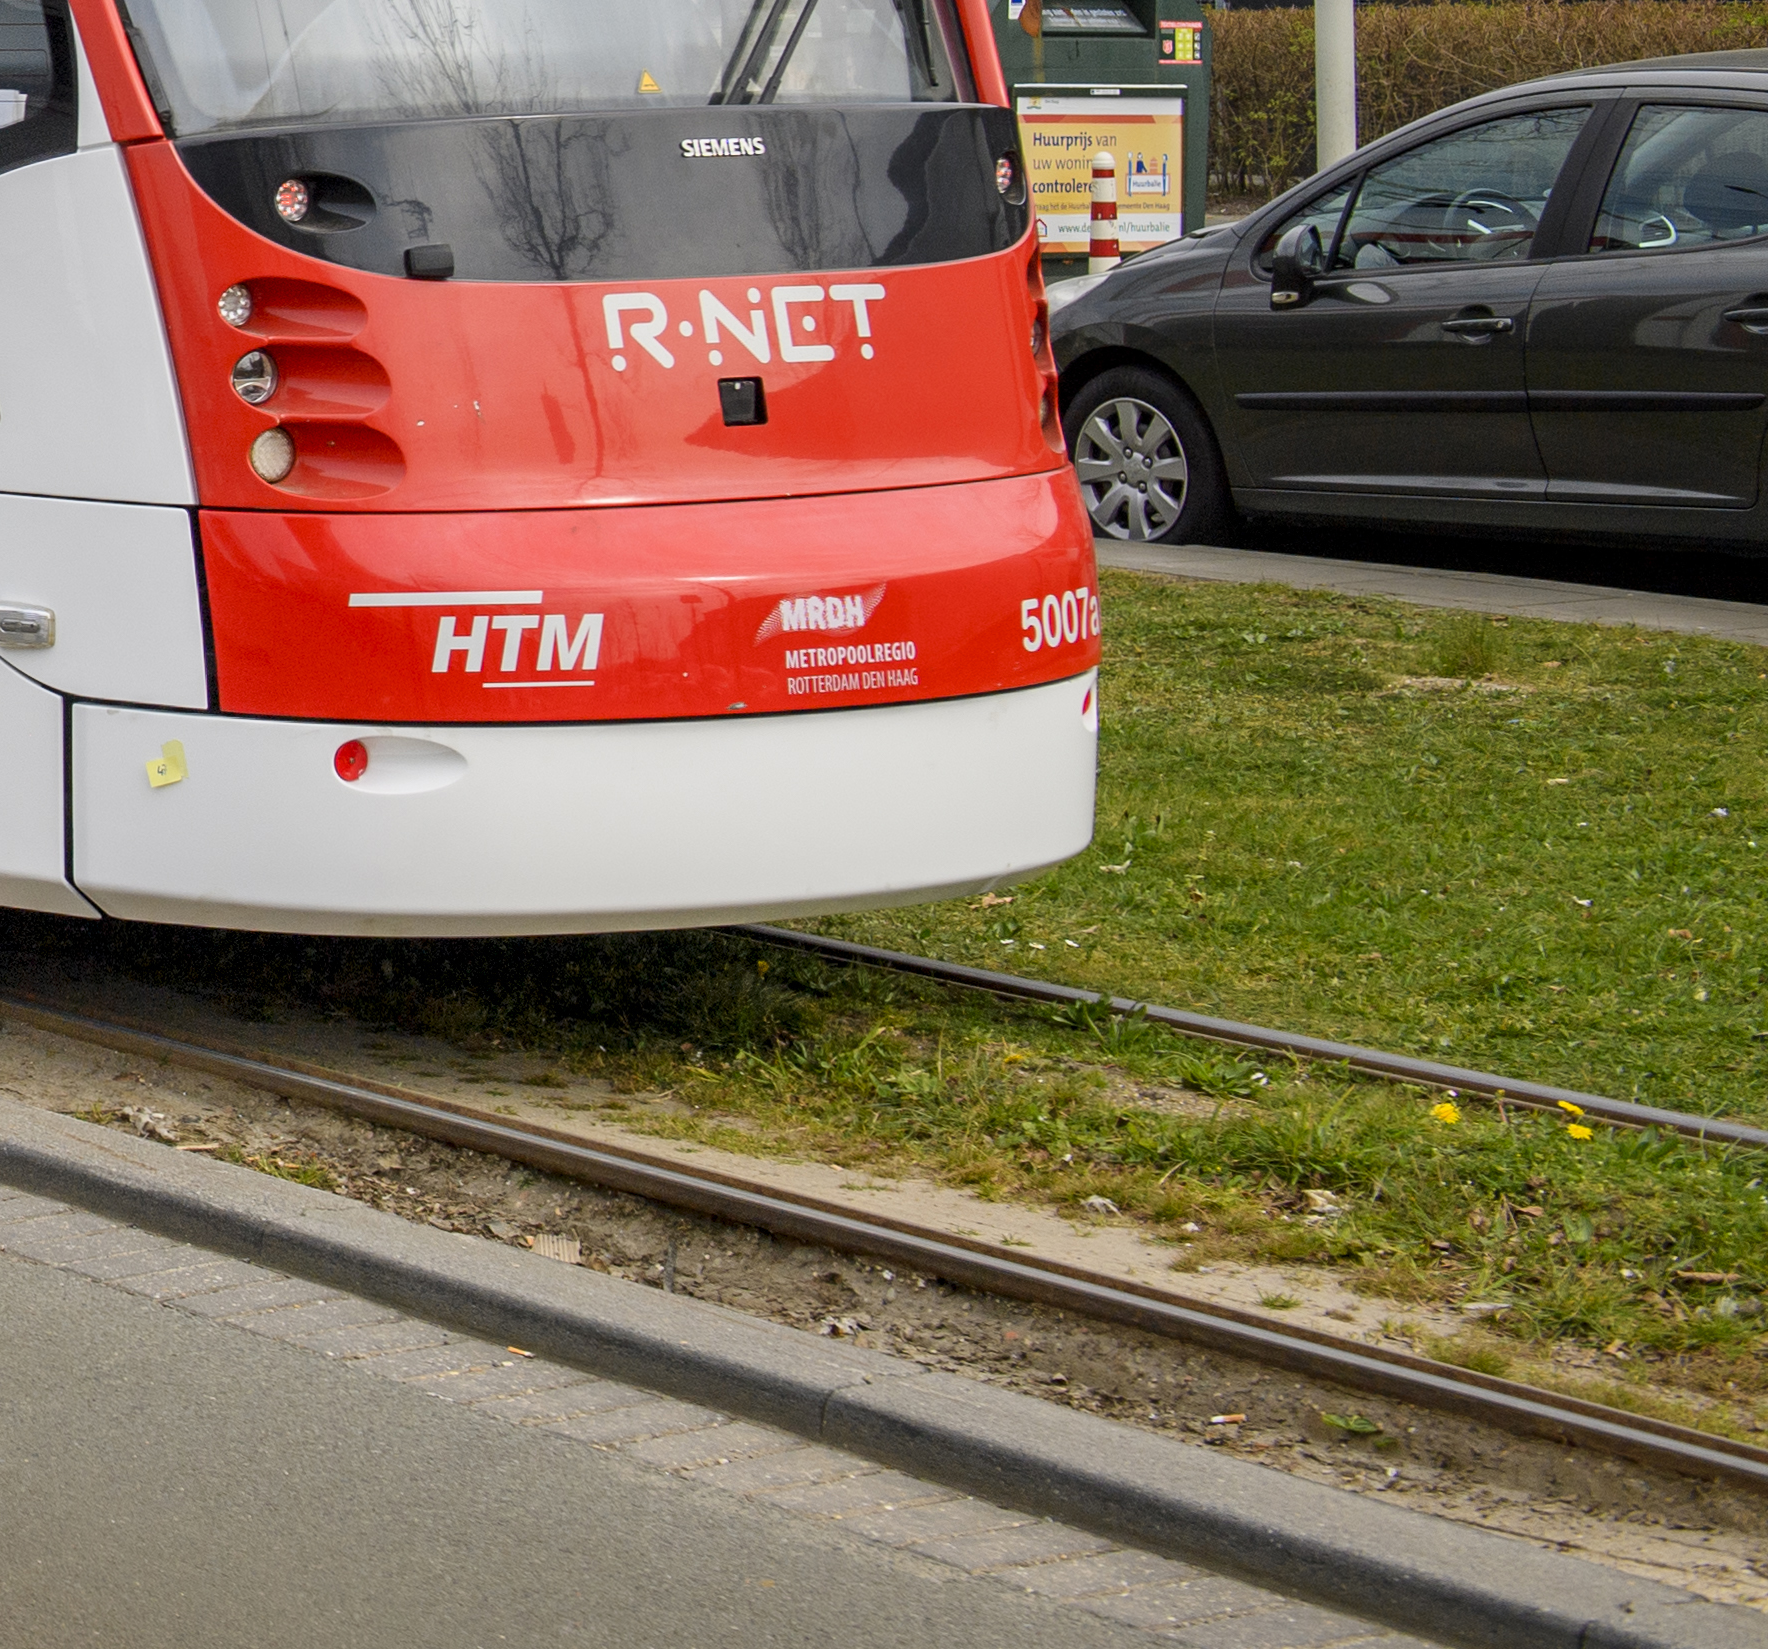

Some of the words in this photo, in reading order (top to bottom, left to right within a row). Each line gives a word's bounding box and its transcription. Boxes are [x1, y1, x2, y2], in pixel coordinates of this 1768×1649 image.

[680, 137, 766, 158] SIEMENS
[1032, 131, 1093, 151] Huurprijs
[1096, 135, 1117, 147] van
[1033, 159, 1052, 170] uw
[1055, 155, 1093, 170] wonin
[1032, 178, 1094, 194] controlere
[1132, 179, 1162, 189] Huurbalie
[1035, 204, 1049, 212] raag
[1117, 202, 1142, 210] emeente
[779, 595, 865, 632] MRDH
[1021, 586, 1101, 653] 5007a
[431, 613, 605, 674] HTM
[785, 640, 916, 670] METROPOOLREGIO
[787, 672, 861, 695] ROTTERDAM
[862, 671, 886, 690] DEN
[888, 668, 919, 687] HAAG
